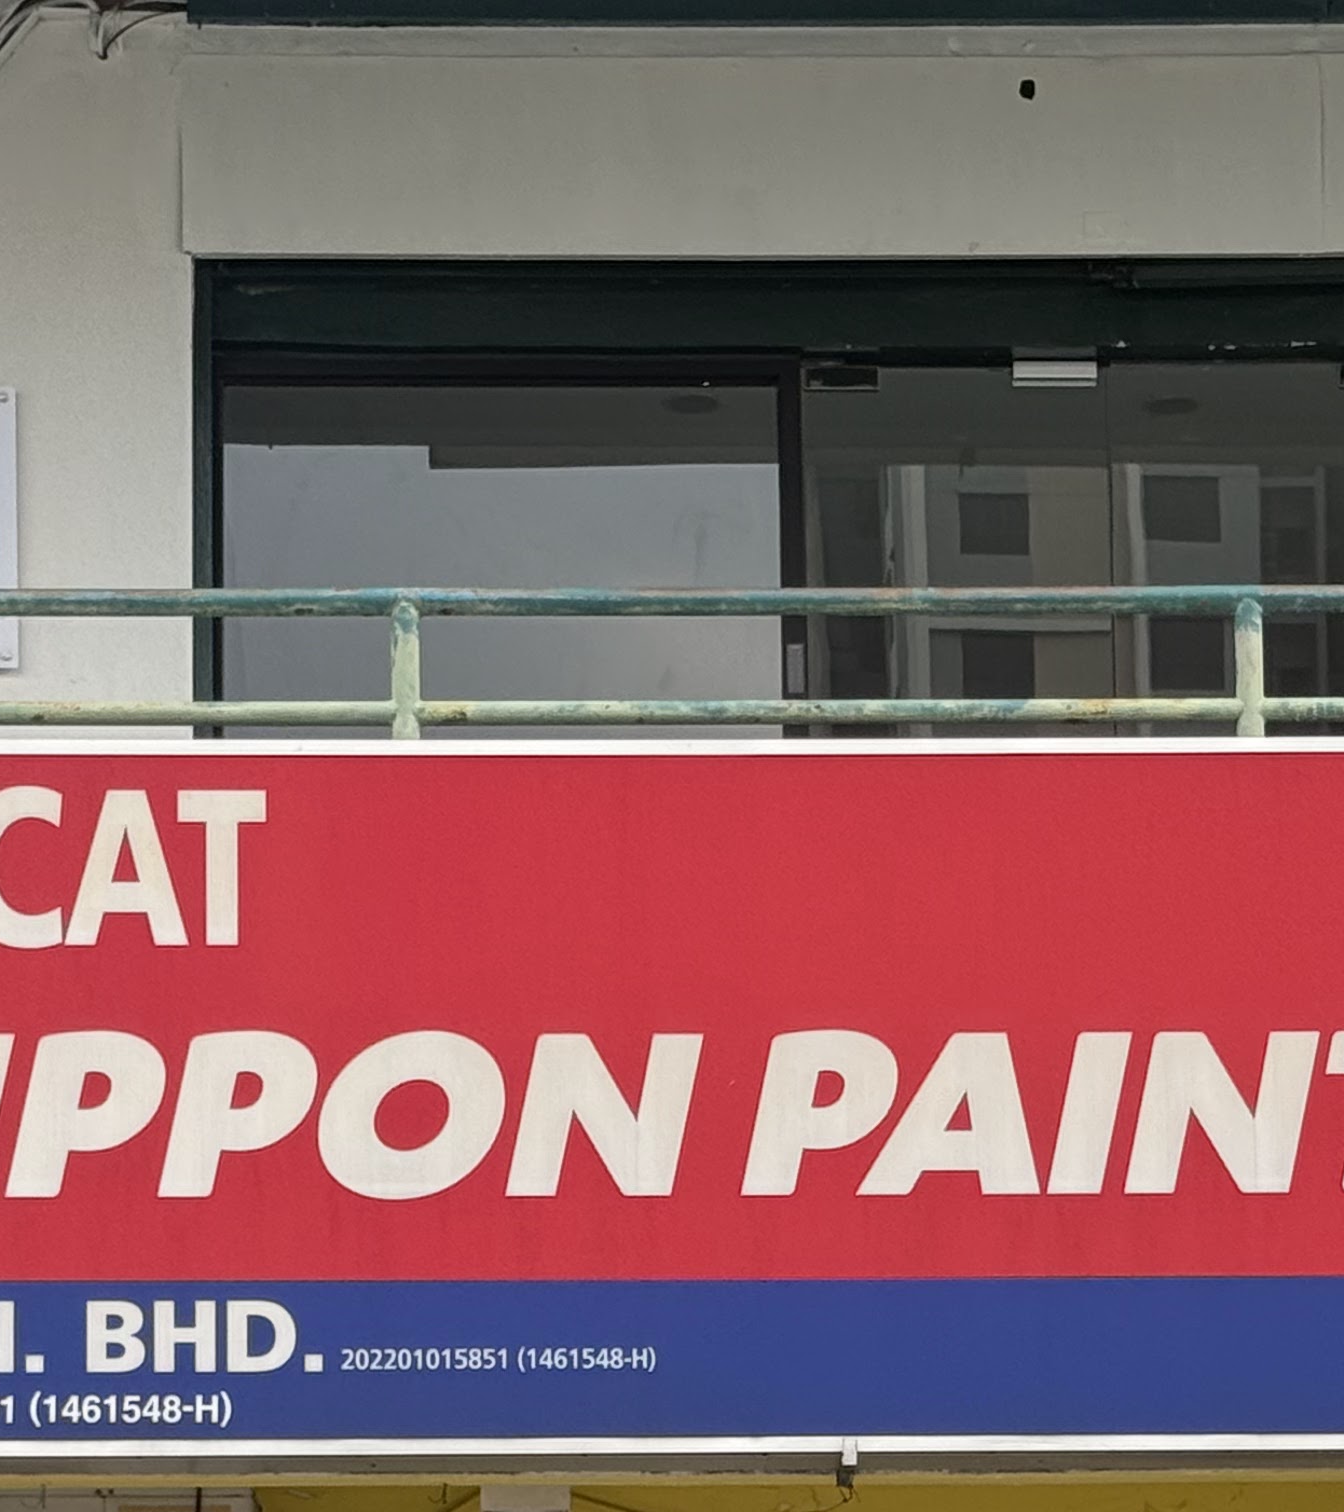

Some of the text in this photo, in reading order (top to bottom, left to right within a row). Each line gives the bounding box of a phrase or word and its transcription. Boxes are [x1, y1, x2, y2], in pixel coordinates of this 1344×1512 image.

[85, 1300, 324, 1374] BHD.
[340, 1347, 509, 1371] 202201015851
[516, 1345, 657, 1373] (1461548-H)
[28, 1391, 233, 1429] (1461548-H)
